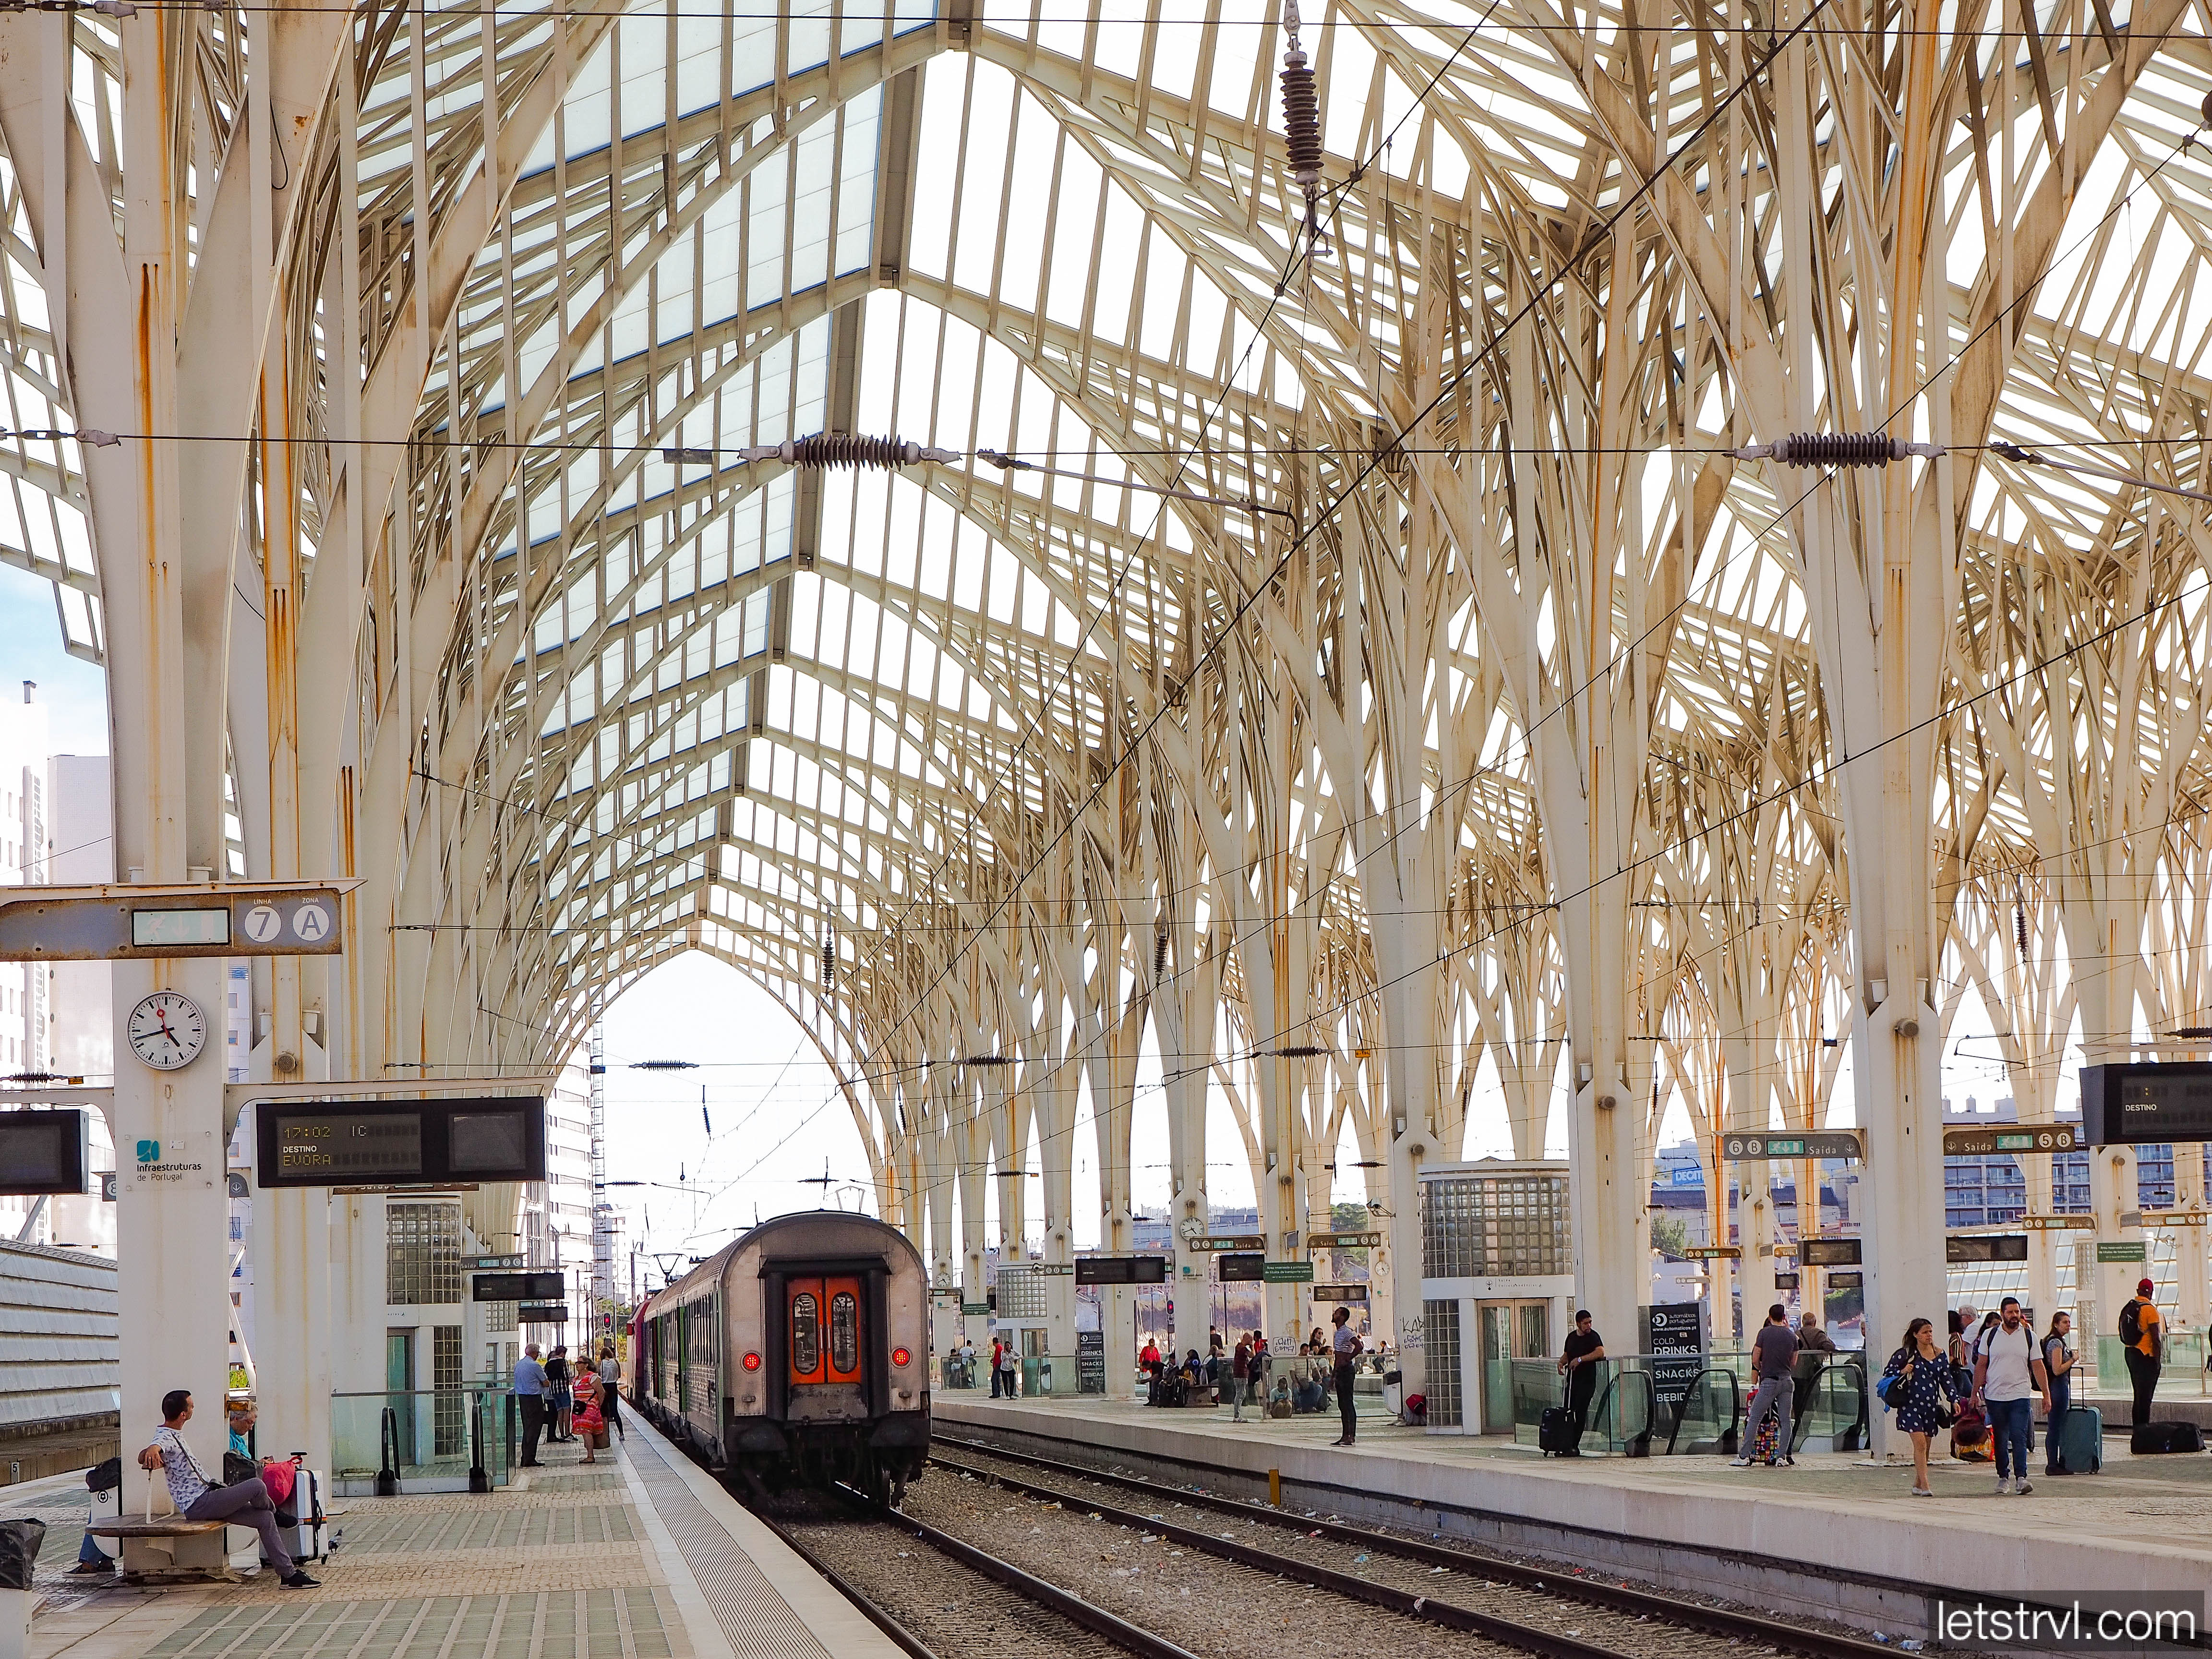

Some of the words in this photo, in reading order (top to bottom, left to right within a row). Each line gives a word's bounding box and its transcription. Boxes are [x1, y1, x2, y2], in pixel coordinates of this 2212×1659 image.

[254, 912, 271, 937] 7
[301, 911, 322, 935] A
[284, 1127, 330, 1138] 17:02
[352, 1126, 366, 1137] IC
[2042, 1135, 2049, 1145] 5
[2061, 1135, 2067, 1145] B
[1732, 1142, 1739, 1153] 6
[1752, 1142, 1757, 1152] B
[283, 1154, 331, 1166] EVORA
[137, 1163, 202, 1172] Infraestruturas
[151, 1172, 182, 1182] Portugal
[1654, 1345, 1698, 1355] DRINKS
[12, 1463, 18, 1473] 5
